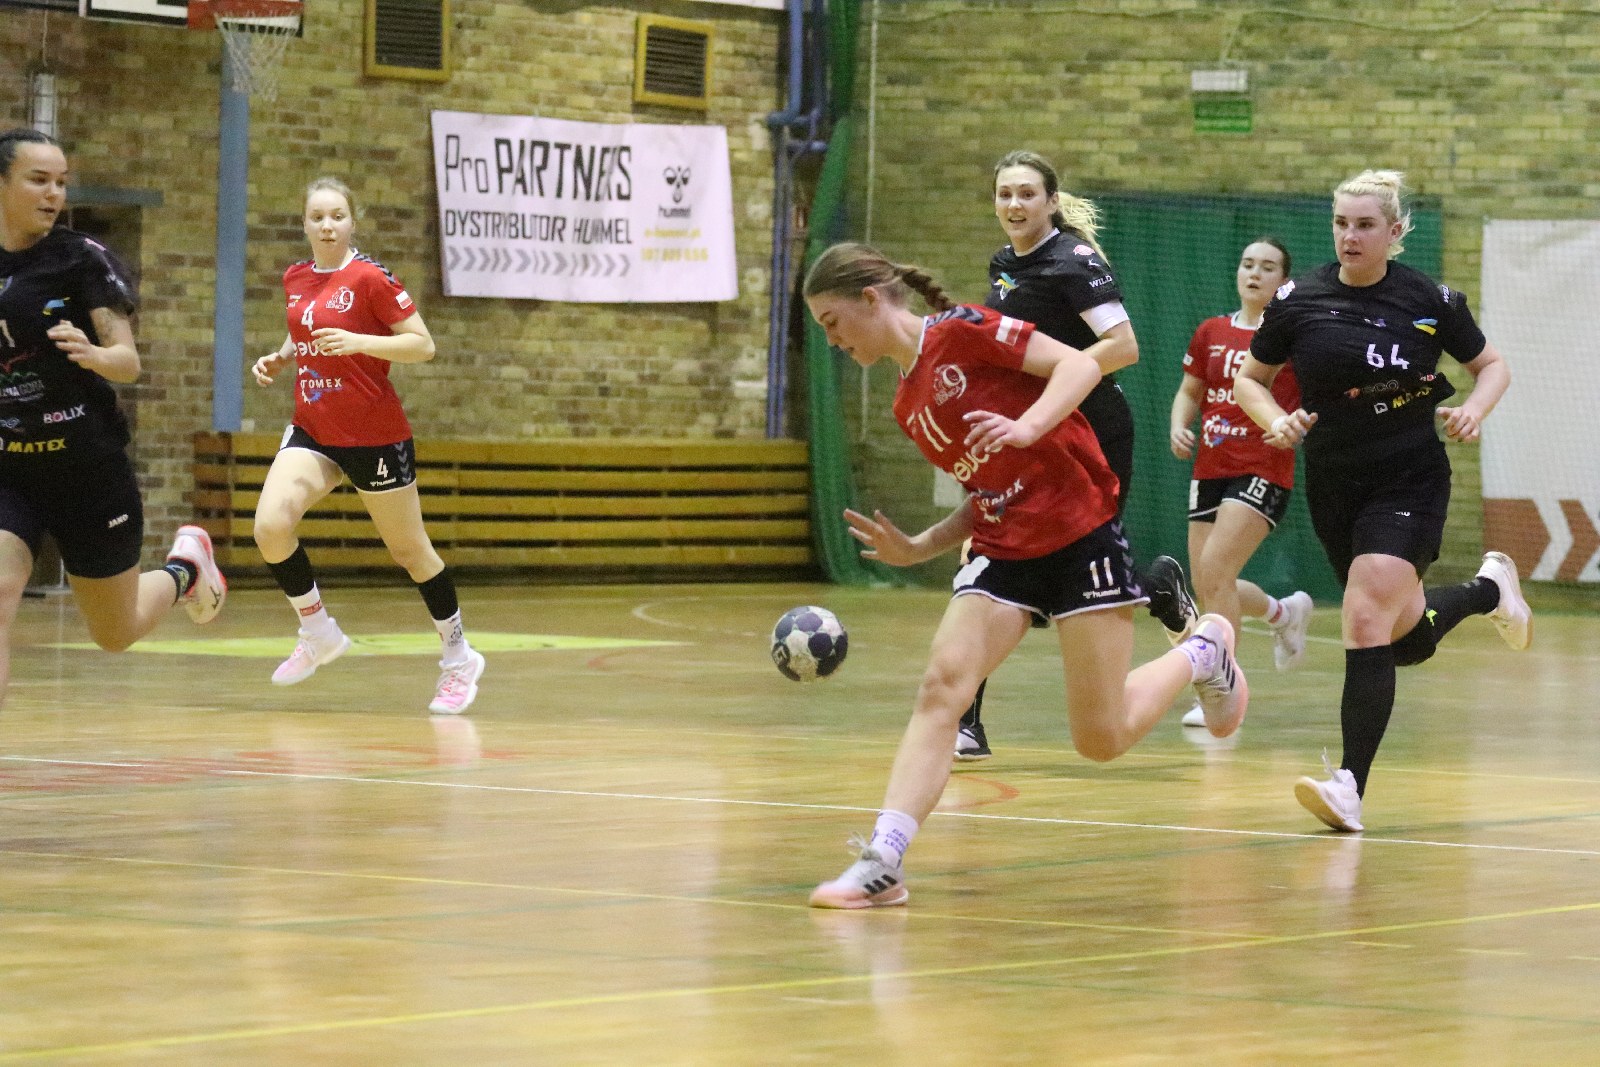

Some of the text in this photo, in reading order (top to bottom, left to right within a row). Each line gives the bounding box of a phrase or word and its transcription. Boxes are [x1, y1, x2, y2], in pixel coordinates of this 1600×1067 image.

[446, 134, 489, 193] Pro
[1089, 275, 1113, 288] WILD
[301, 300, 316, 331] 4
[1366, 343, 1410, 369] 64
[43, 403, 86, 424] BOLIX
[918, 405, 953, 452] 11
[7, 438, 67, 453] MATEX
[376, 457, 389, 478] 4
[1247, 476, 1270, 500] 15
[1089, 556, 1113, 588] 11
